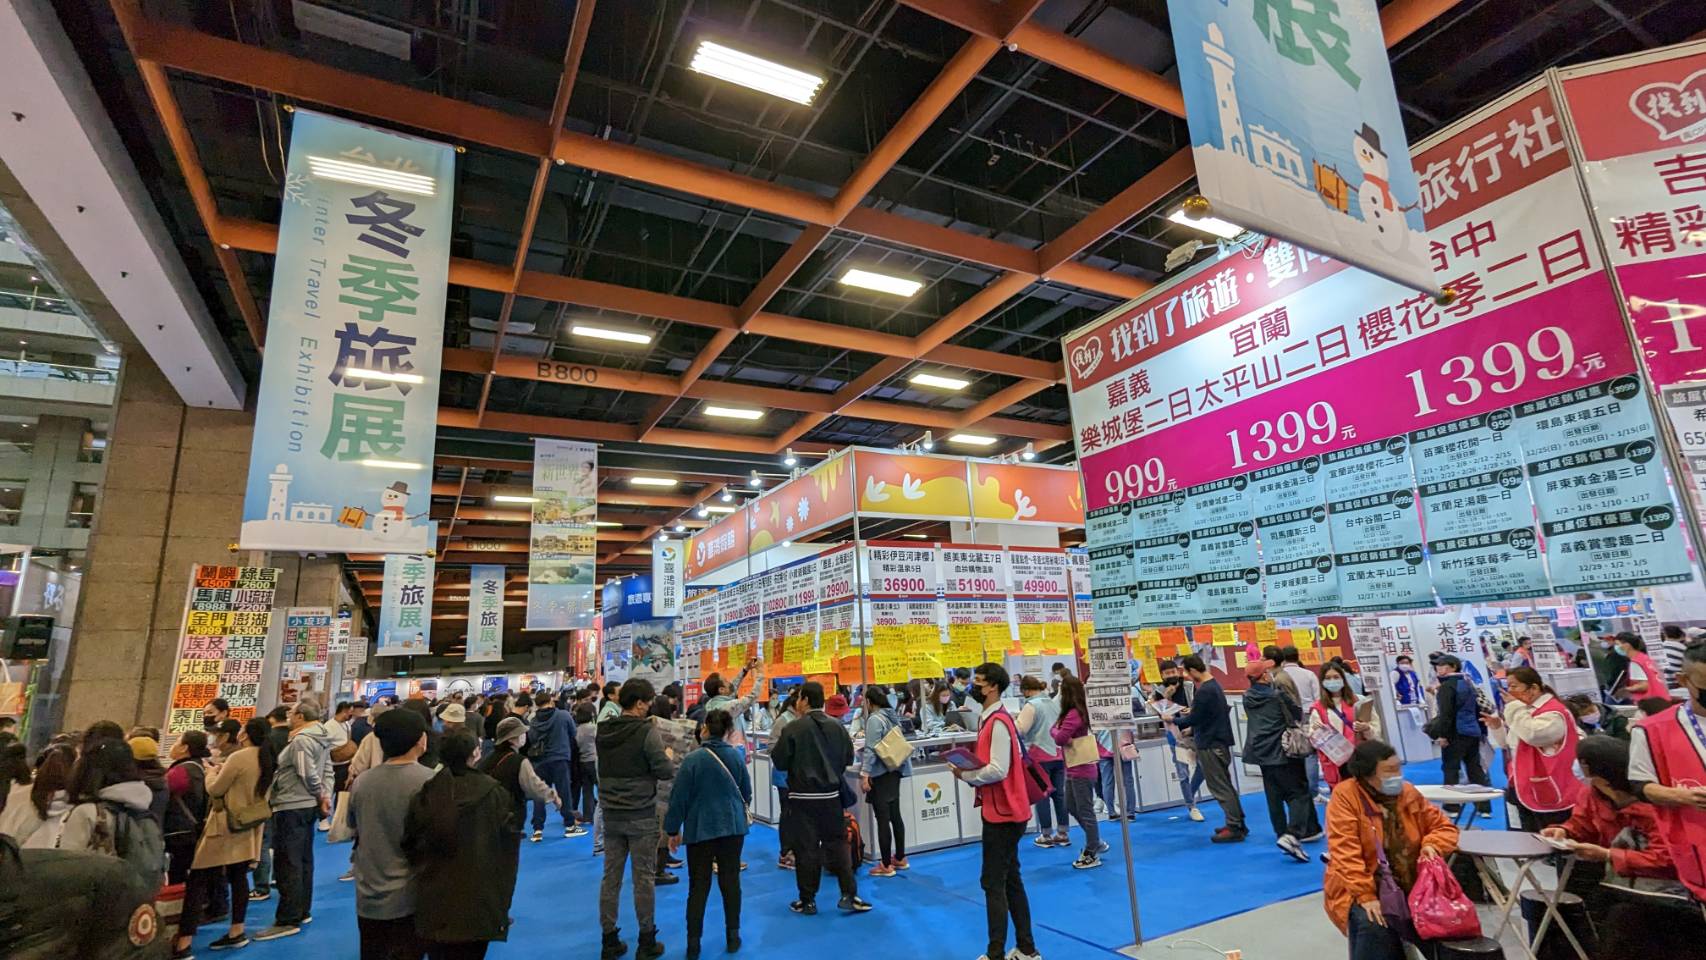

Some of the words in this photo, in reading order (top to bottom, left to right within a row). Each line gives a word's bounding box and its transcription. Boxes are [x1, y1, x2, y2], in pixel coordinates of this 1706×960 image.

[1414, 105, 1569, 213] 旅行社
[304, 258, 327, 319] Travel
[1357, 229, 1591, 351] 櫻花季二日
[320, 190, 426, 462] 冬季旅展
[1229, 306, 1291, 357] 宜蘭
[1195, 324, 1349, 411] 太平山二日
[288, 336, 318, 452] Exhibition
[1106, 369, 1152, 409] 嘉義
[1523, 386, 1602, 413] 旅展促銷優惠
[1080, 387, 1193, 452] 樂城堡二日
[1536, 402, 1622, 431] 環島東環五日
[1417, 417, 1481, 440] 旅展促銷優惠
[1565, 424, 1600, 437] 出發日期
[1424, 431, 1503, 458] 苗栗櫻花開一日
[1538, 447, 1617, 472] 旅展促銷優惠
[1427, 473, 1492, 494] 旅展促銷優惠
[1546, 464, 1647, 493] 屏東黃金湯三日
[1430, 489, 1512, 513] 宜蘭足湯趣一日
[1579, 487, 1616, 500] 出發日期
[1345, 510, 1401, 528] 台中谷關二日
[1553, 511, 1633, 533] 旅展促銷優惠
[1642, 511, 1670, 524] $1399
[1436, 533, 1502, 552] 旅展促銷優惠
[1560, 530, 1666, 554] 嘉義賞雪趣二日
[1440, 548, 1538, 570] 新竹採草莓季一日
[1593, 551, 1630, 561] 出發日期
[1633, 559, 1648, 567] 1/5
[241, 567, 275, 581] 綠島
[1346, 565, 1417, 581] 宜蘭太平山二日
[826, 580, 849, 598] 29900
[884, 578, 925, 592] 36900
[958, 578, 996, 592] 51900
[1024, 580, 1058, 592] 49900
[196, 589, 231, 603] 馬祖
[235, 590, 274, 604] 小琉球
[192, 612, 228, 626] 金門
[232, 613, 268, 626] 澎湖
[480, 580, 500, 642] 冬季旅展
[187, 637, 223, 650] 埃及
[227, 636, 266, 650] 土耳其
[182, 660, 219, 674] 北越
[224, 660, 260, 674] 峴港
[222, 684, 257, 698] 沖繩
